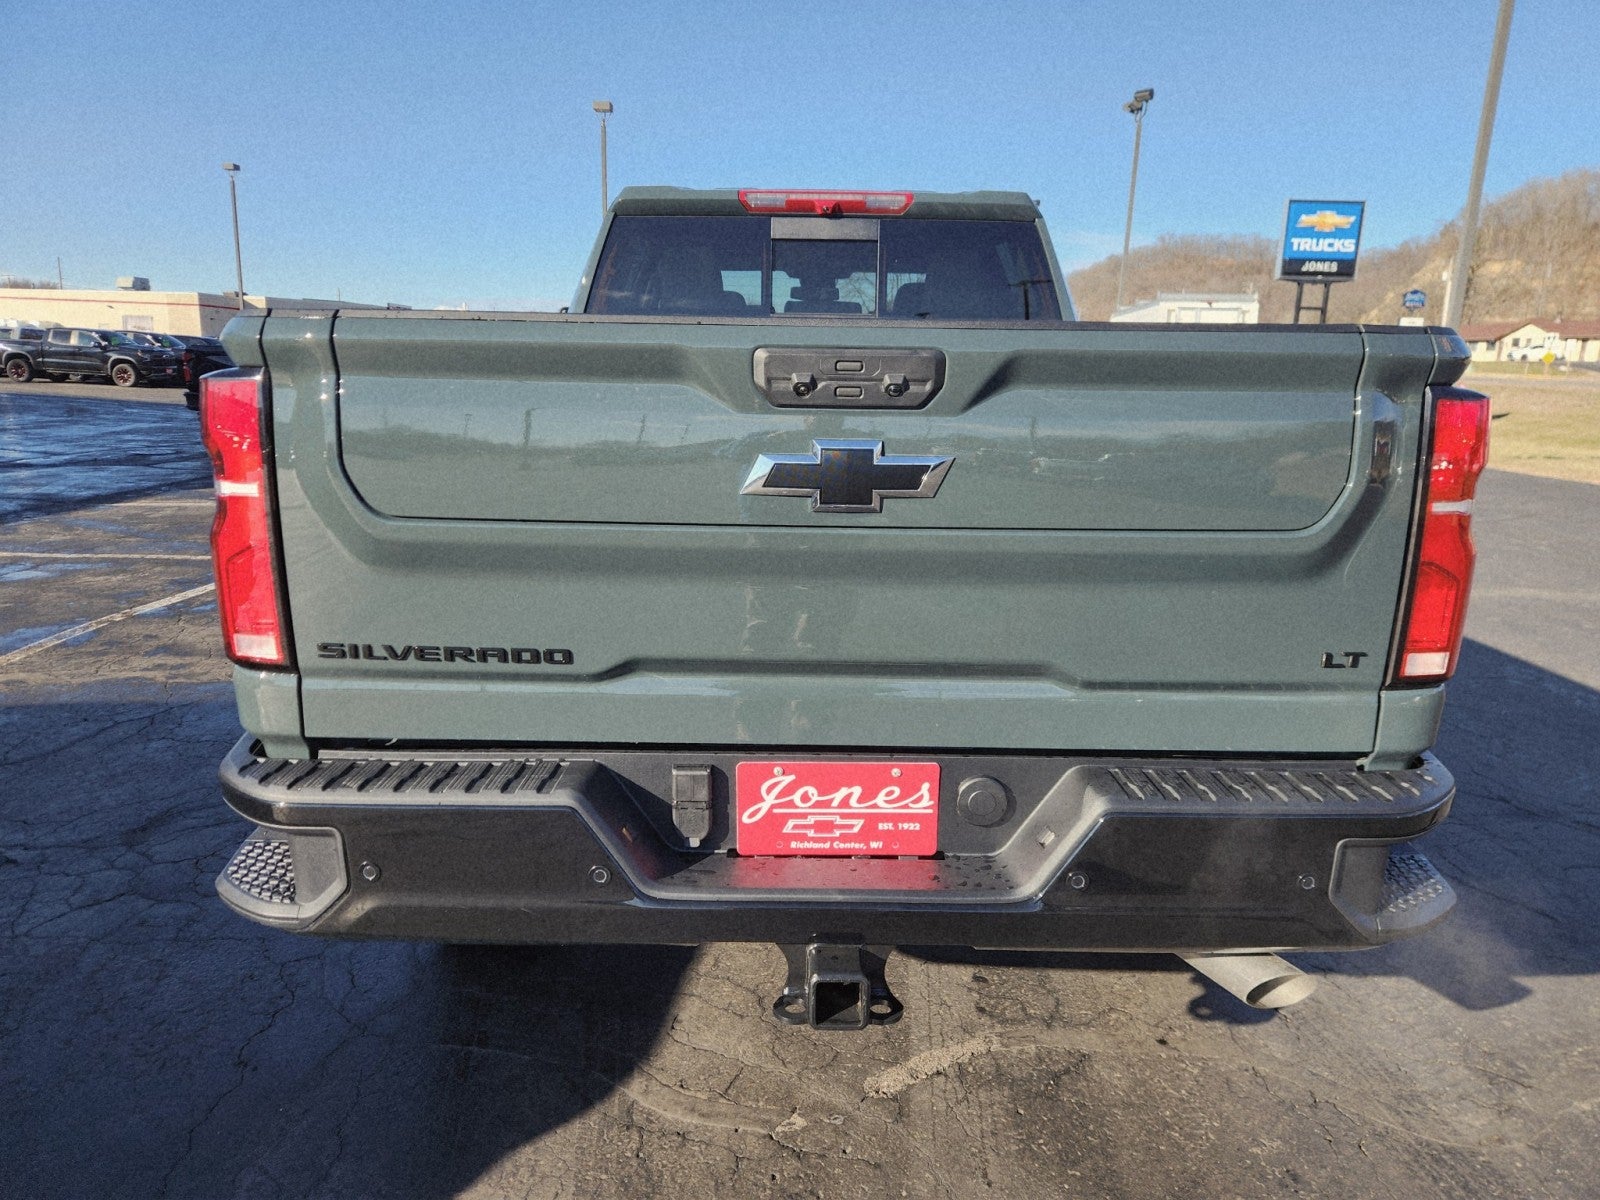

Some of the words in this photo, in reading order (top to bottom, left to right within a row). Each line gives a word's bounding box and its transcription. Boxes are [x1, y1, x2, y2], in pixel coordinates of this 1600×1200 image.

[1291, 237, 1356, 253] TRUCKS
[1301, 261, 1338, 272] JONES
[317, 642, 574, 665] SILVERADO
[1321, 651, 1368, 669] LT
[742, 774, 934, 824] Jones
[878, 822, 895, 831] EST.
[898, 822, 920, 831] 1922
[790, 840, 830, 849] Richland
[833, 840, 866, 850] Center,
[870, 840, 883, 849] WI
